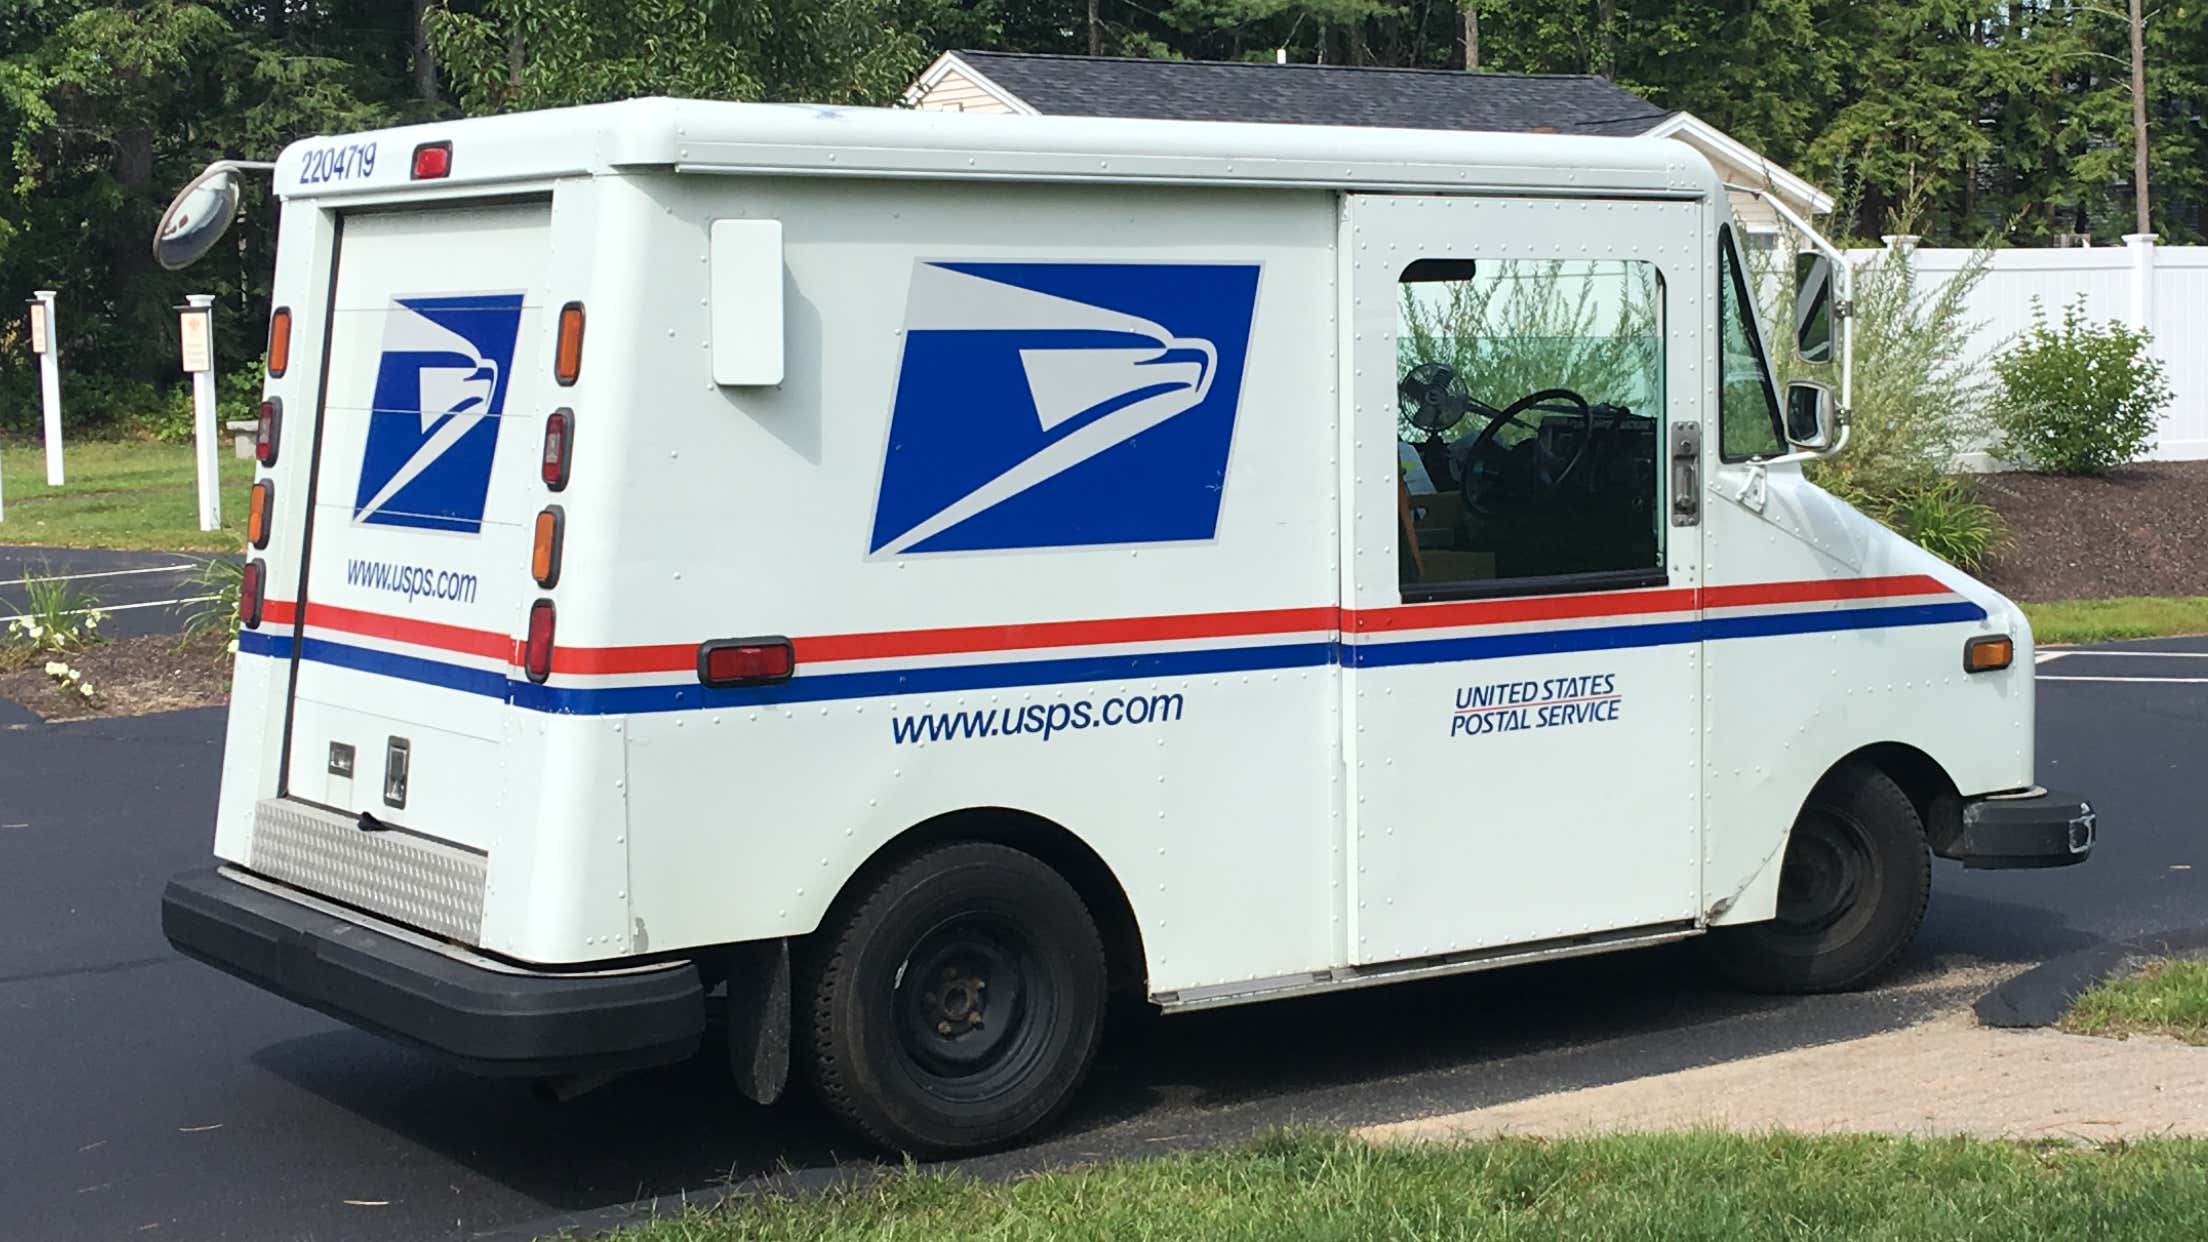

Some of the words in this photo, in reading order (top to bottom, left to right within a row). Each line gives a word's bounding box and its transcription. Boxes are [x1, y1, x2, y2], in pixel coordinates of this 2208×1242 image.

[300, 142, 377, 184] 2204719
[347, 558, 477, 603] www.usps.com
[1456, 681, 1538, 709] UNITED
[1542, 673, 1615, 700] STATES
[892, 693, 1184, 745] www.usps.com
[1451, 709, 1530, 737] POSTAL
[1536, 699, 1621, 728] SERVICE
